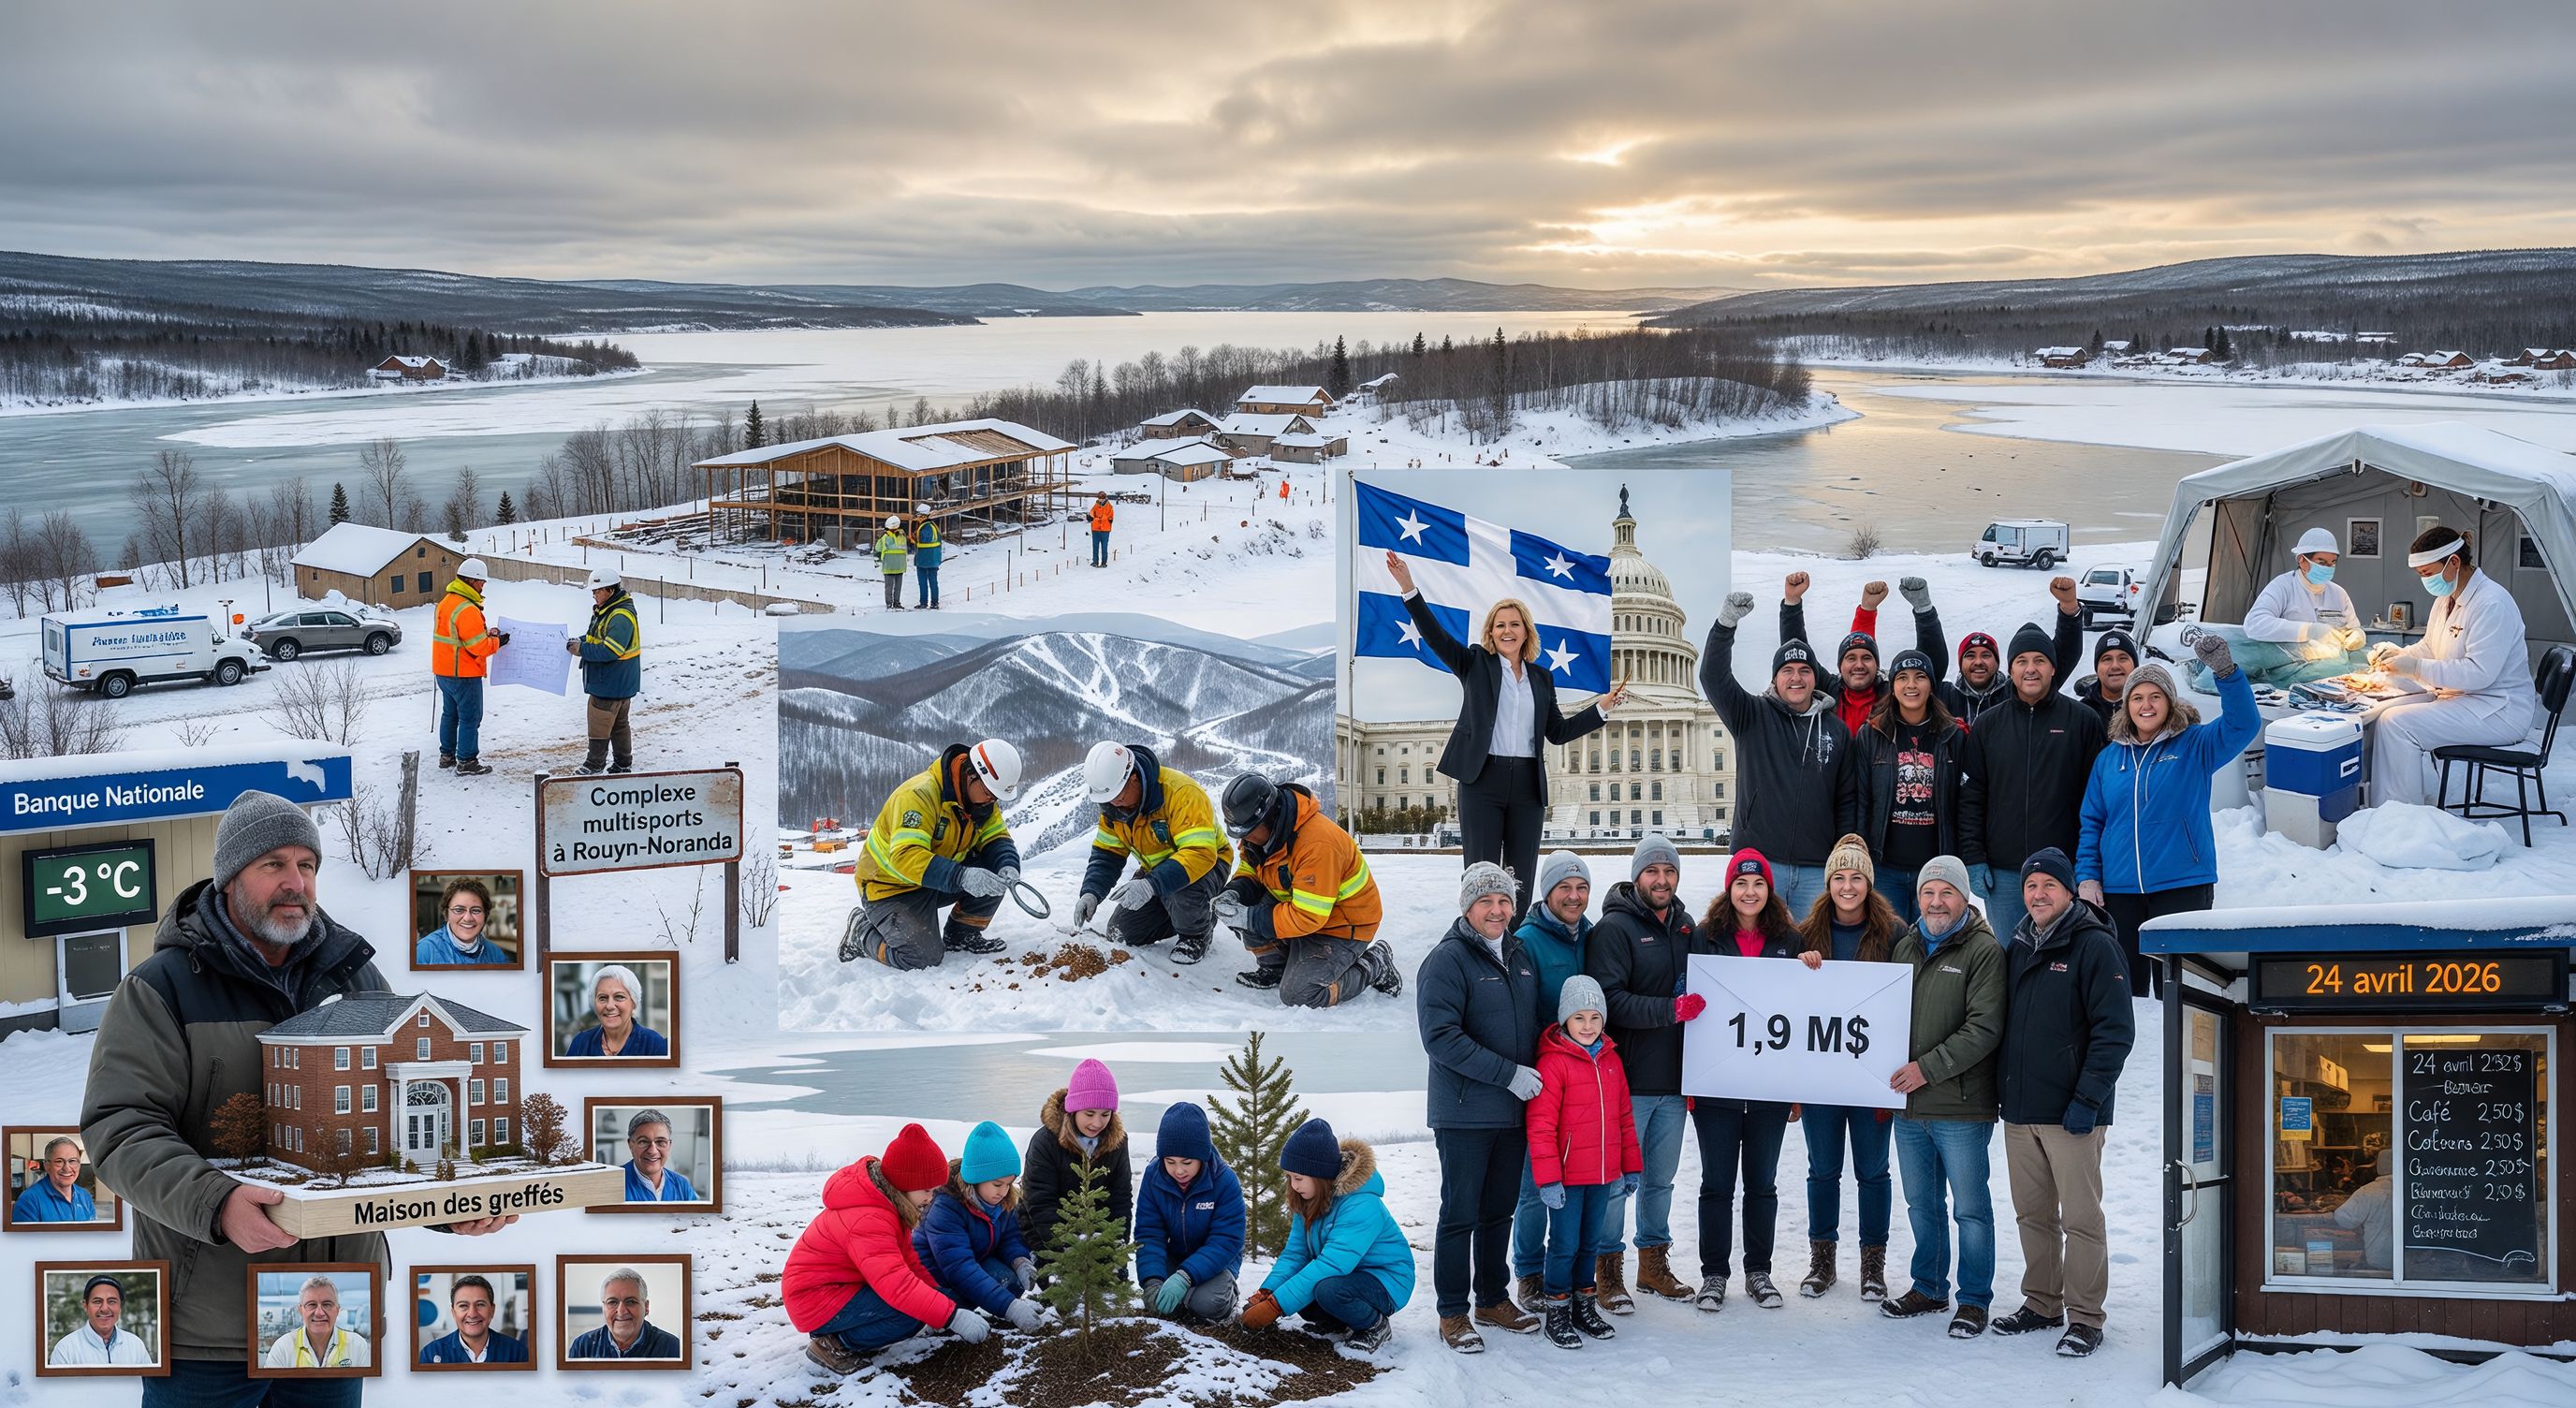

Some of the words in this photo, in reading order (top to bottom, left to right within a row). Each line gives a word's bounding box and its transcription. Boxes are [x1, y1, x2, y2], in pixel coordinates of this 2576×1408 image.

[14, 792, 99, 815] Banque
[105, 779, 205, 808] Nationale
[591, 784, 696, 808] Complexe
[583, 809, 703, 833] multisports
[553, 843, 565, 862] à
[573, 831, 732, 862] Rouyn-Noranda
[2306, 964, 2343, 994] 24
[2353, 963, 2413, 993] avril
[2425, 962, 2501, 992] 2026
[1729, 1012, 1792, 1056] 1,9
[1808, 1015, 1870, 1059] M$
[2412, 1052, 2436, 1075] 24
[2408, 1100, 2452, 1124] Café
[355, 1198, 436, 1225] Maison
[444, 1192, 482, 1215] des
[489, 1181, 564, 1216] greffés
